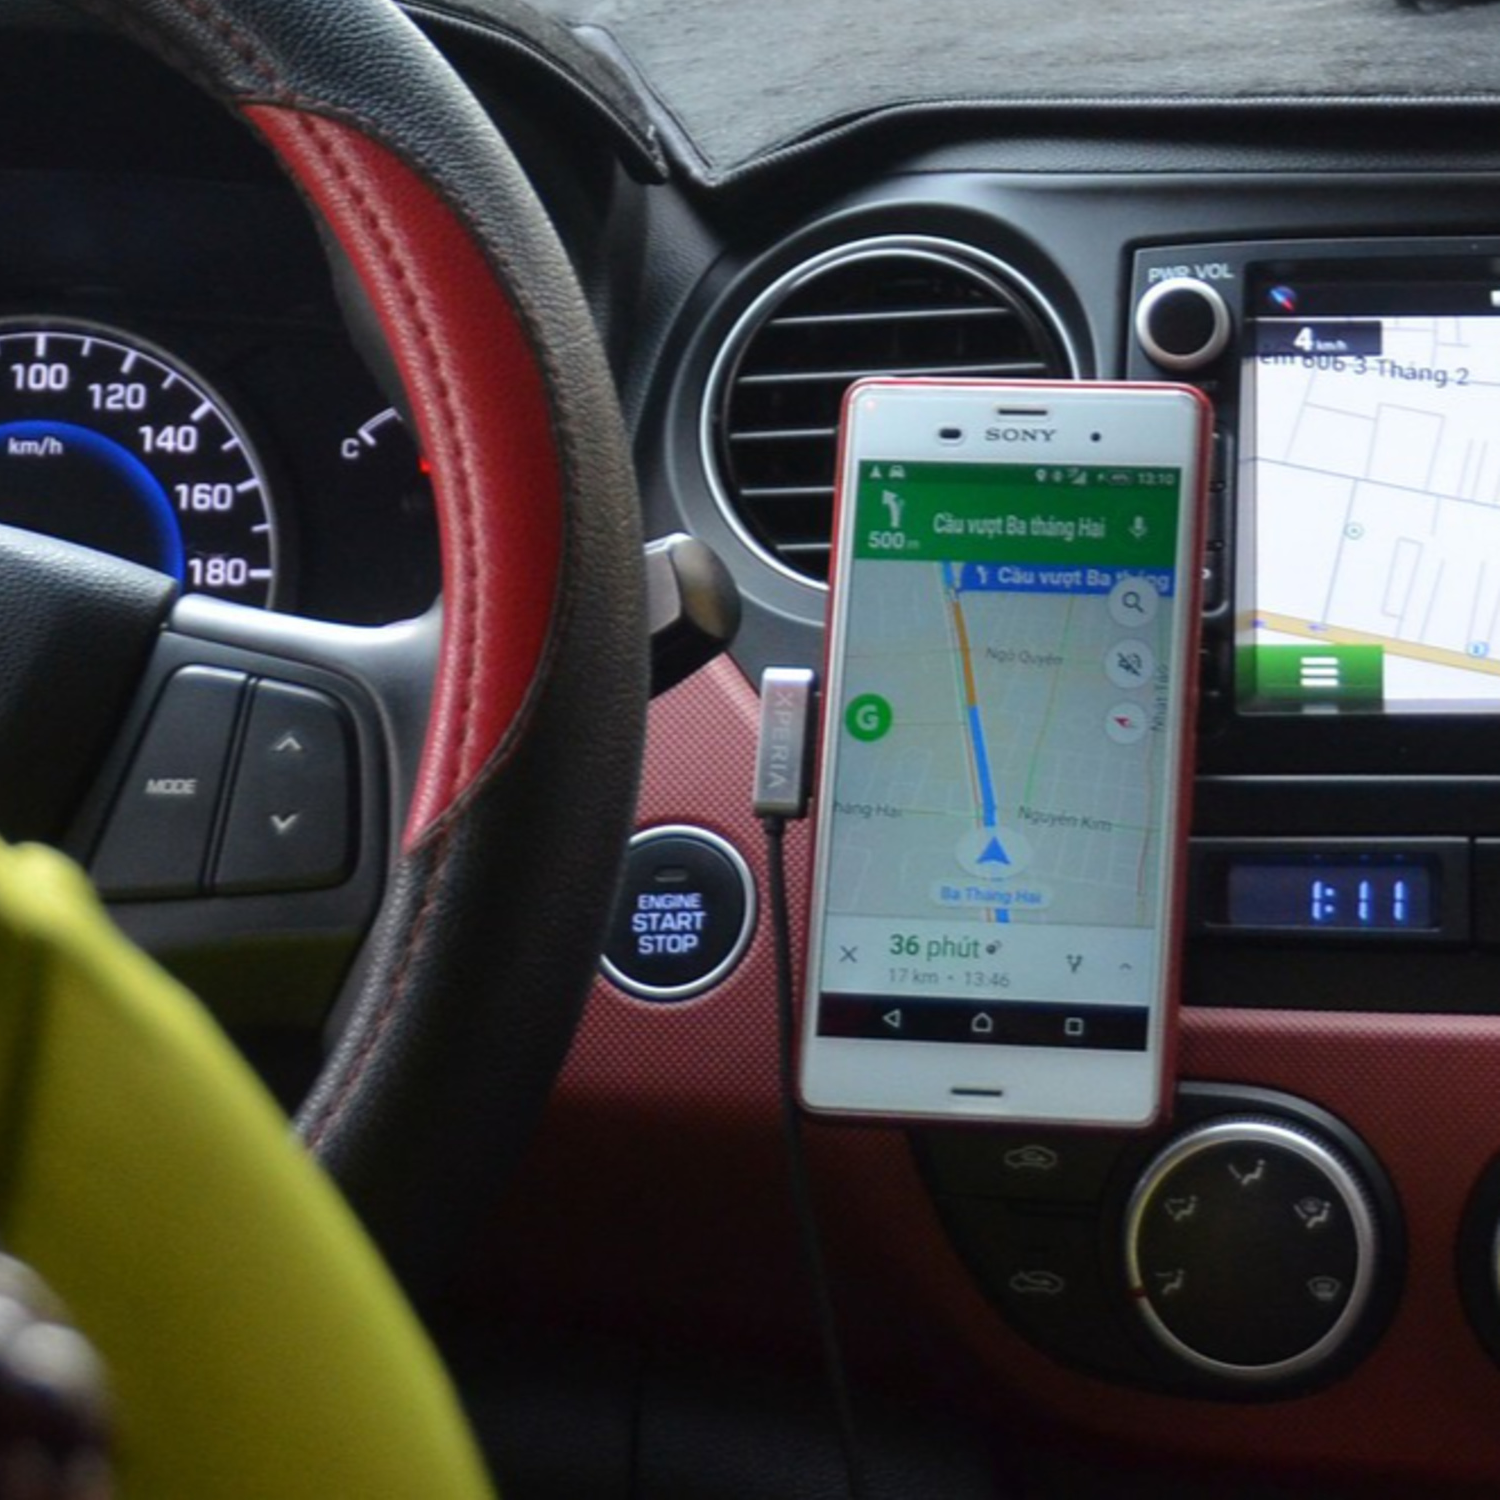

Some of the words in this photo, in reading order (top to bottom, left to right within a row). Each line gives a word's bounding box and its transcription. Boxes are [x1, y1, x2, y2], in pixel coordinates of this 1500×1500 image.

[1148, 264, 1190, 283] PWR
[1194, 263, 1234, 279] VOL
[1293, 327, 1313, 351] 4
[11, 363, 69, 390] 100
[1455, 367, 1470, 386] 2
[88, 383, 146, 410] 120
[8, 435, 63, 457] km/h
[138, 425, 198, 452] 140
[985, 428, 1057, 442] SONY
[341, 437, 360, 460] C
[175, 483, 233, 511] 160
[1006, 514, 1027, 536] Ba
[1078, 516, 1107, 538] Hai
[868, 530, 905, 549] 500
[188, 558, 247, 586] 180
[1086, 569, 1111, 586] Ba
[855, 704, 879, 731] G
[767, 691, 794, 788] XPERIA
[145, 778, 198, 795] MODE
[637, 893, 703, 910] ENGINE
[1311, 880, 1406, 921] 1:11
[631, 911, 706, 932] START
[638, 934, 699, 954] STOP
[889, 933, 920, 955] 36
[926, 934, 980, 962] phút
[889, 967, 909, 982] 17
[911, 967, 940, 985] km
[964, 970, 1011, 989] 13:46
